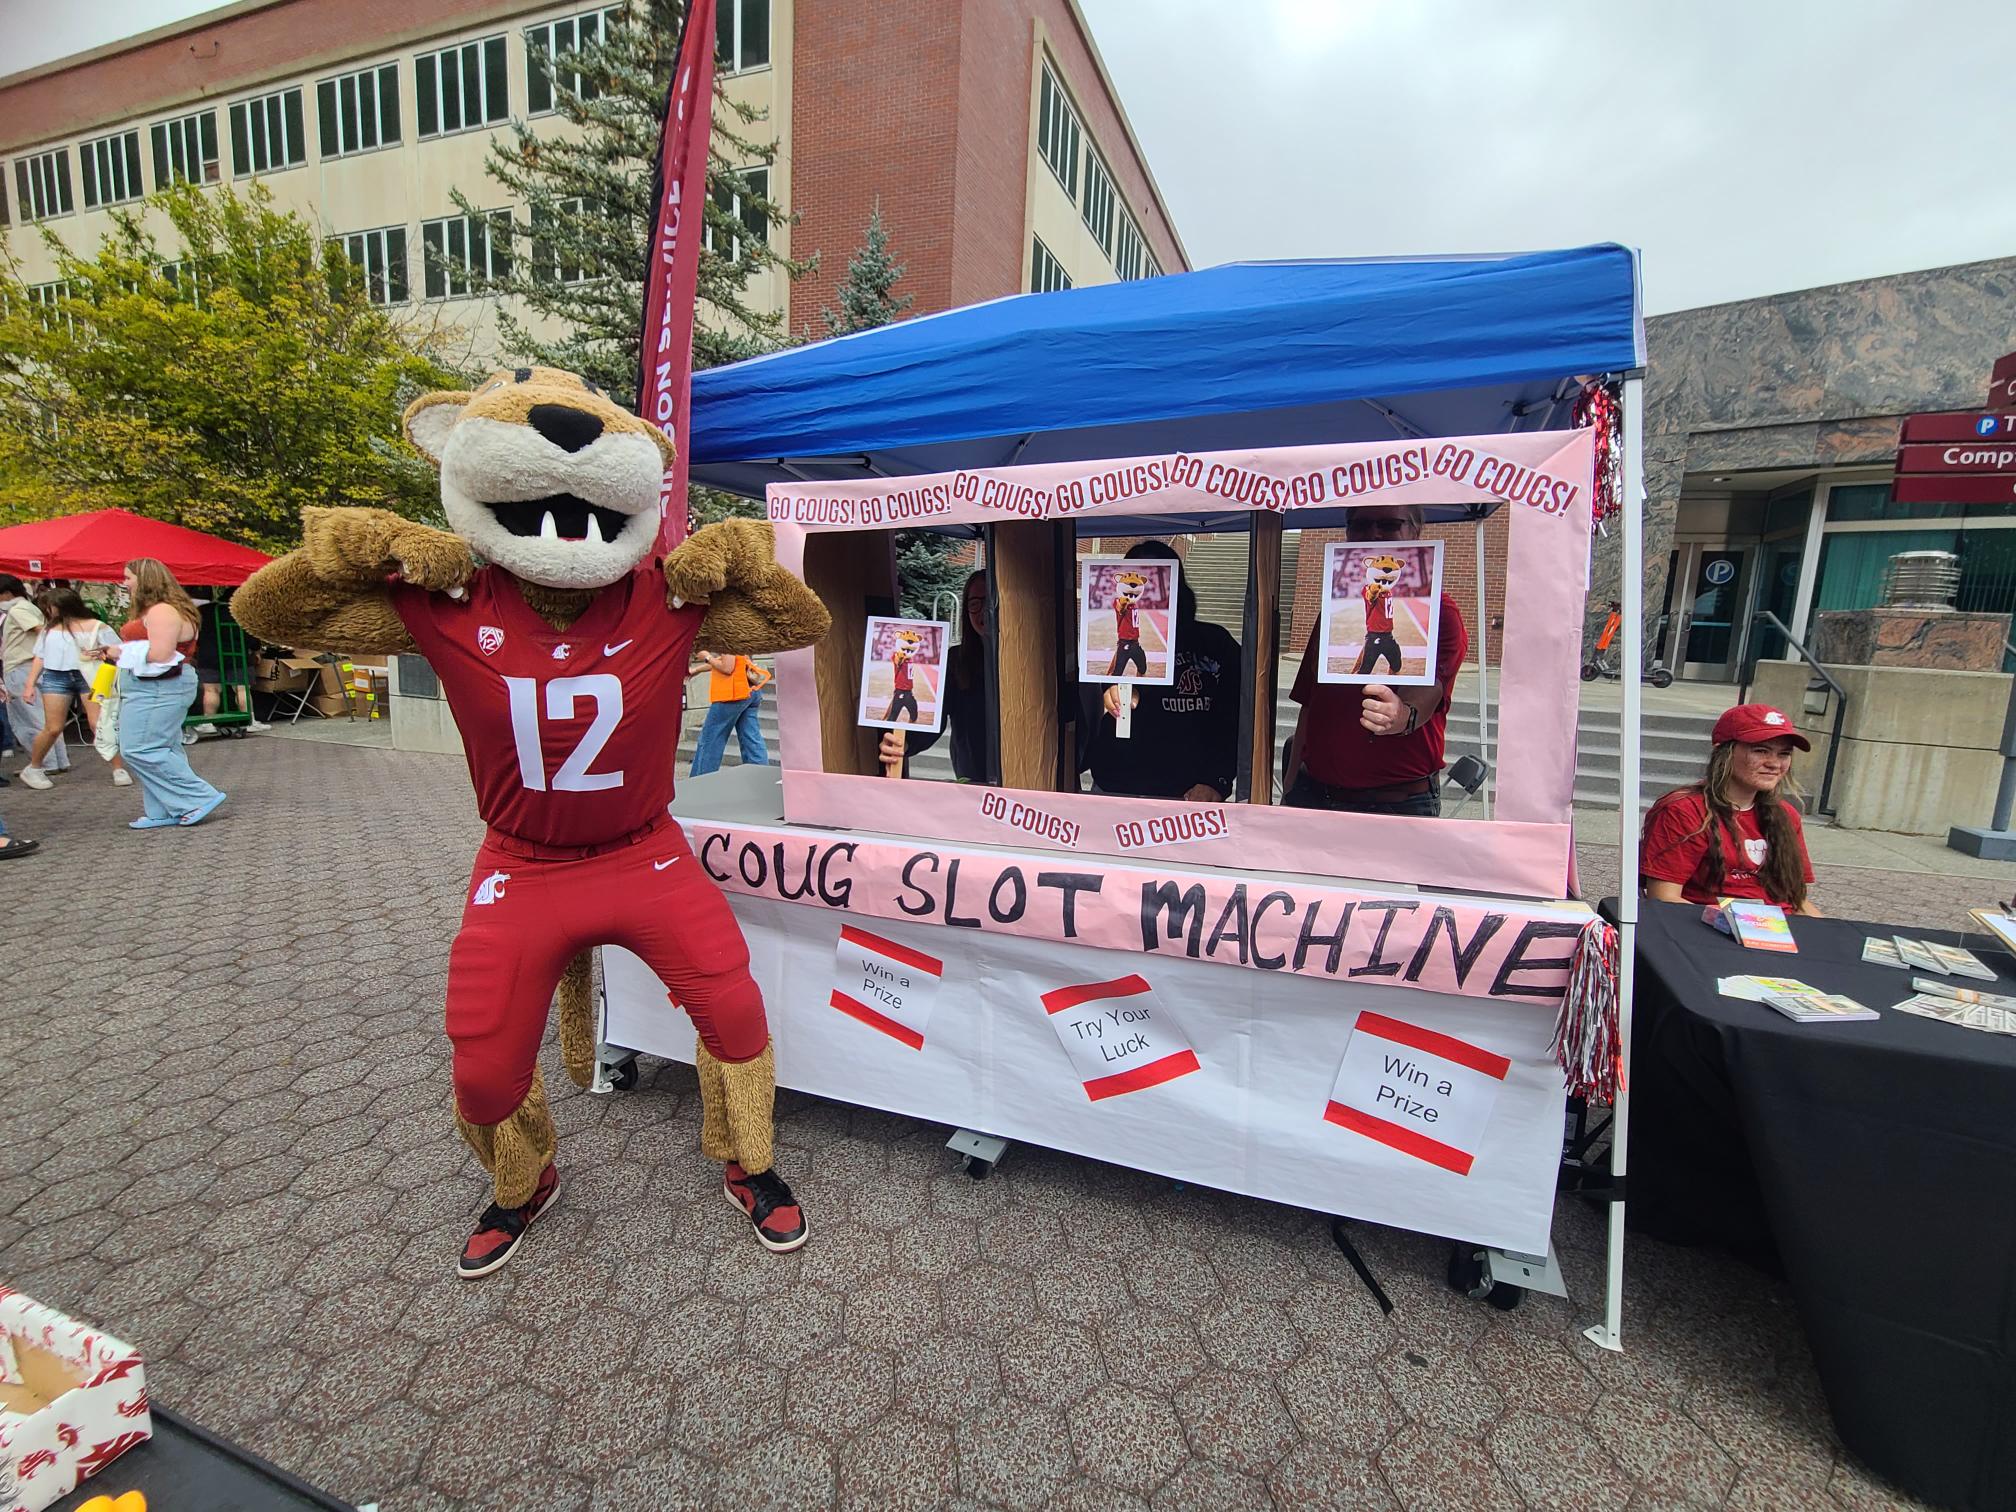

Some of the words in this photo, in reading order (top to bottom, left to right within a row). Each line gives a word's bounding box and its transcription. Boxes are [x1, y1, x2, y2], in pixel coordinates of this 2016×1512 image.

[1291, 472, 1326, 507] GO
[1331, 447, 1429, 498] COUGS!
[1943, 448, 2016, 469] Comp
[953, 472, 980, 502] GO
[982, 479, 1053, 520] COUGS!
[1055, 481, 1085, 513] GO
[1089, 460, 1170, 504] COUGS!
[1170, 454, 1204, 488] GO
[1205, 464, 1290, 513] COUGS!
[1432, 444, 1475, 482] GO
[1473, 457, 1579, 517] COUGS!
[770, 496, 790, 520] GO
[795, 497, 855, 524] COUGS!
[860, 497, 882, 524] GO
[886, 484, 951, 520] COUGS!
[500, 673, 624, 792] 12
[981, 792, 1007, 820] GO
[1010, 803, 1081, 847] COUGS!
[1115, 822, 1145, 848] GO
[1148, 808, 1228, 844] COUGS!
[700, 833, 860, 908] COUG
[893, 852, 1104, 938] SLOT
[1141, 880, 1586, 998] MACHINE
[862, 959, 894, 981] Win
[900, 977, 910, 988] a
[863, 978, 902, 1009] Prize
[1070, 1018, 1103, 1040] Try
[1106, 1008, 1151, 1027] Your
[1100, 1032, 1150, 1062] Luck
[1384, 1055, 1429, 1088] Win
[1436, 1080, 1453, 1097] a
[1376, 1084, 1439, 1123] Prize
